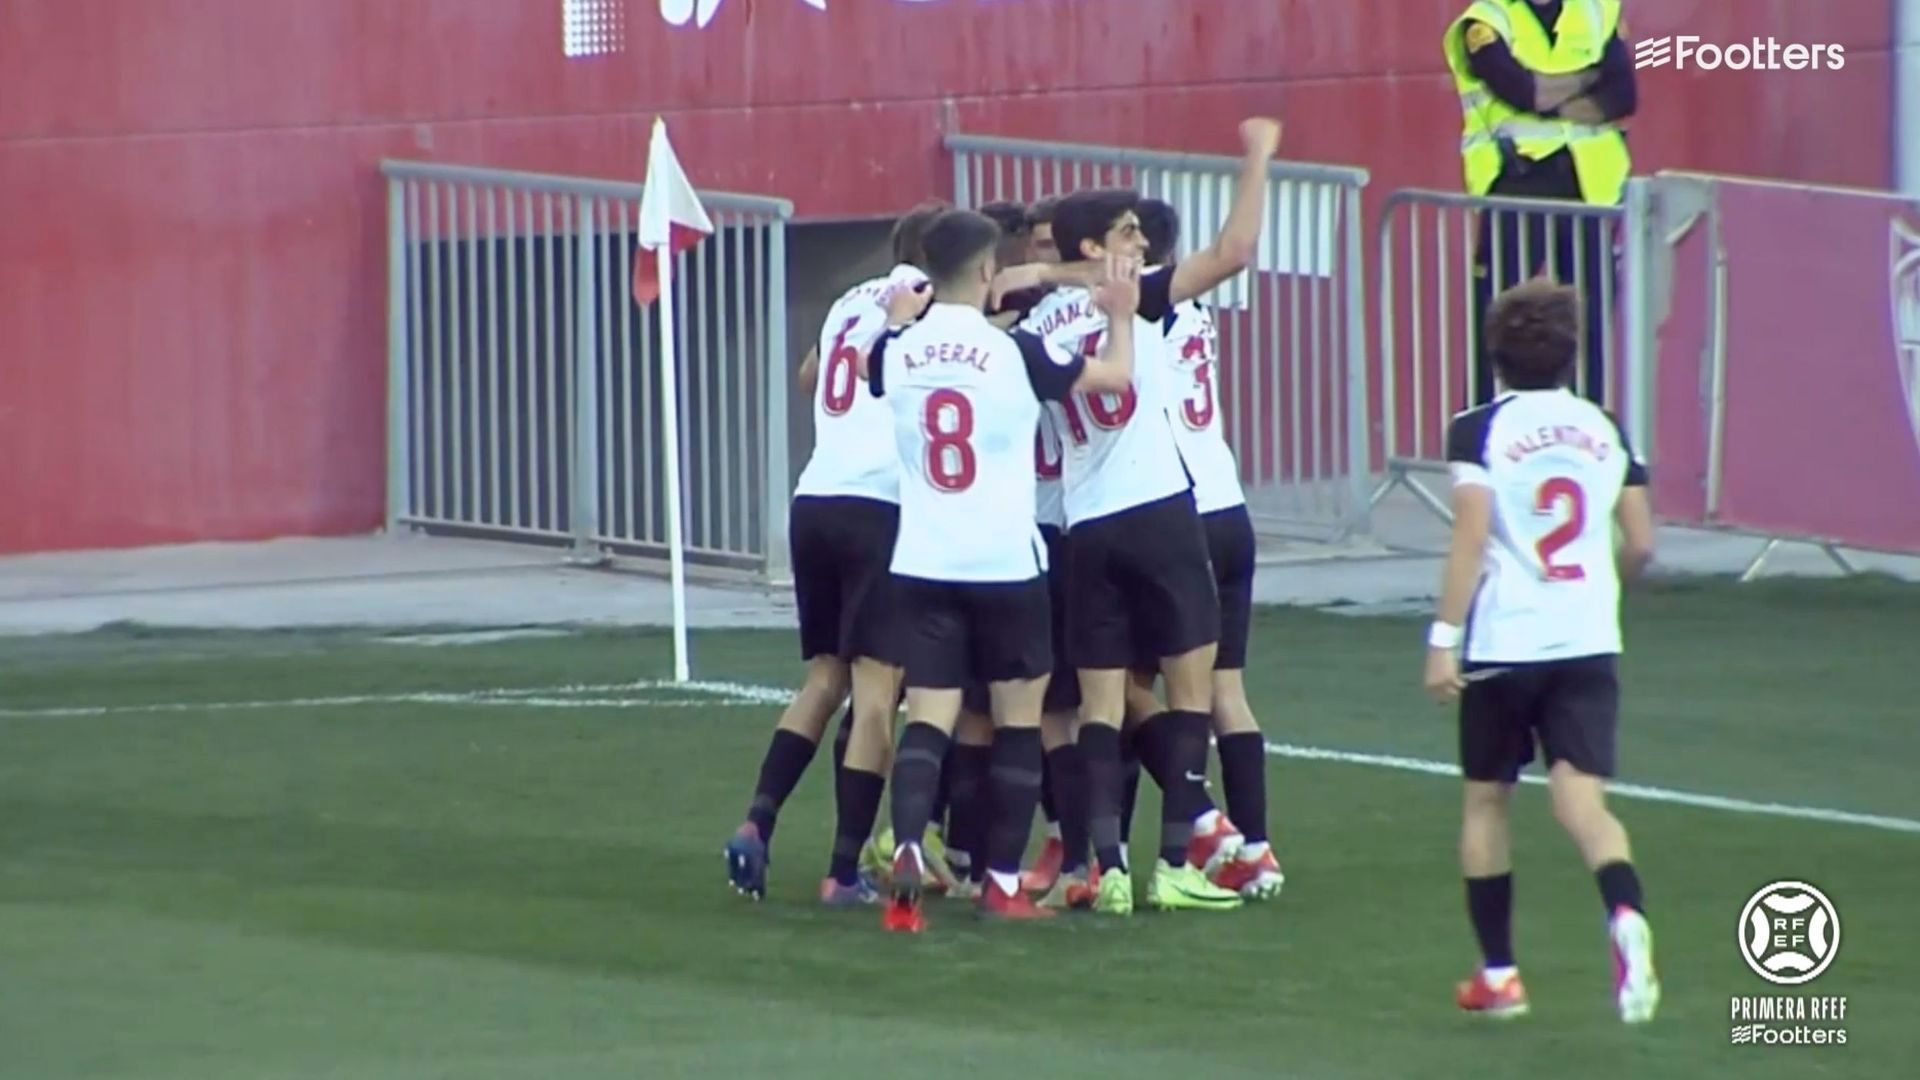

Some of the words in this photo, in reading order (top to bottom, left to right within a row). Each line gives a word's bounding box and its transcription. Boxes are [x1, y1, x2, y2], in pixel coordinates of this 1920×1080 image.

[823, 315, 861, 416] 6
[903, 342, 990, 373] A.PERAL
[1180, 335, 1214, 430] 3
[920, 387, 977, 493] 8
[1534, 476, 1587, 582] 2
